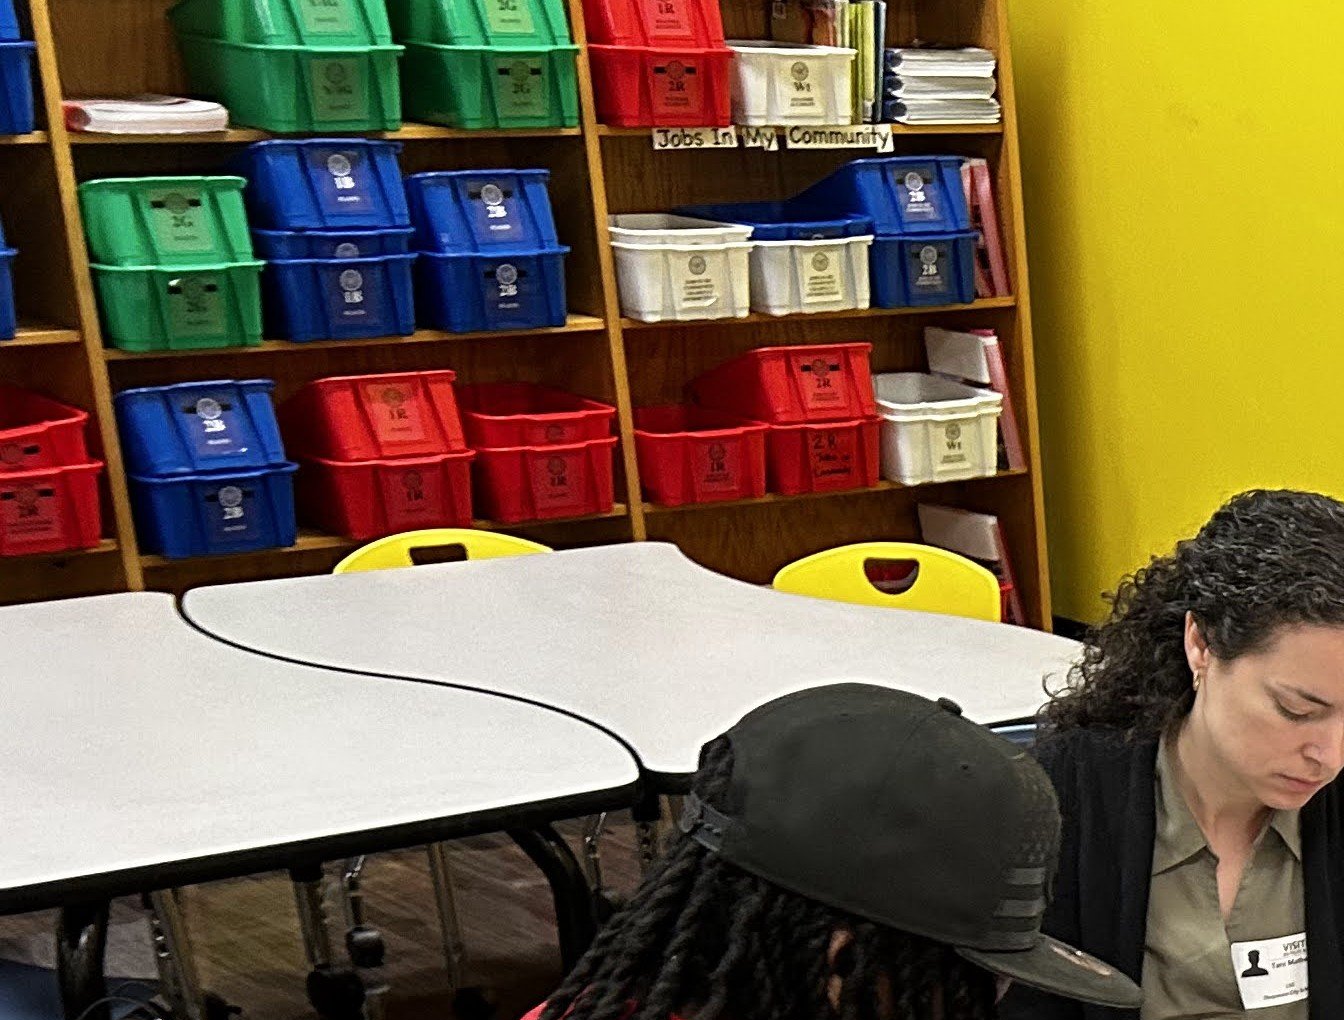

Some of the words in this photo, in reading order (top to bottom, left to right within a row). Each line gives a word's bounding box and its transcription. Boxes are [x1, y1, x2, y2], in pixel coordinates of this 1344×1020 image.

[656, 128, 704, 148] Jobs
[710, 128, 734, 146] In
[742, 126, 775, 149] My
[789, 125, 890, 149] Community
